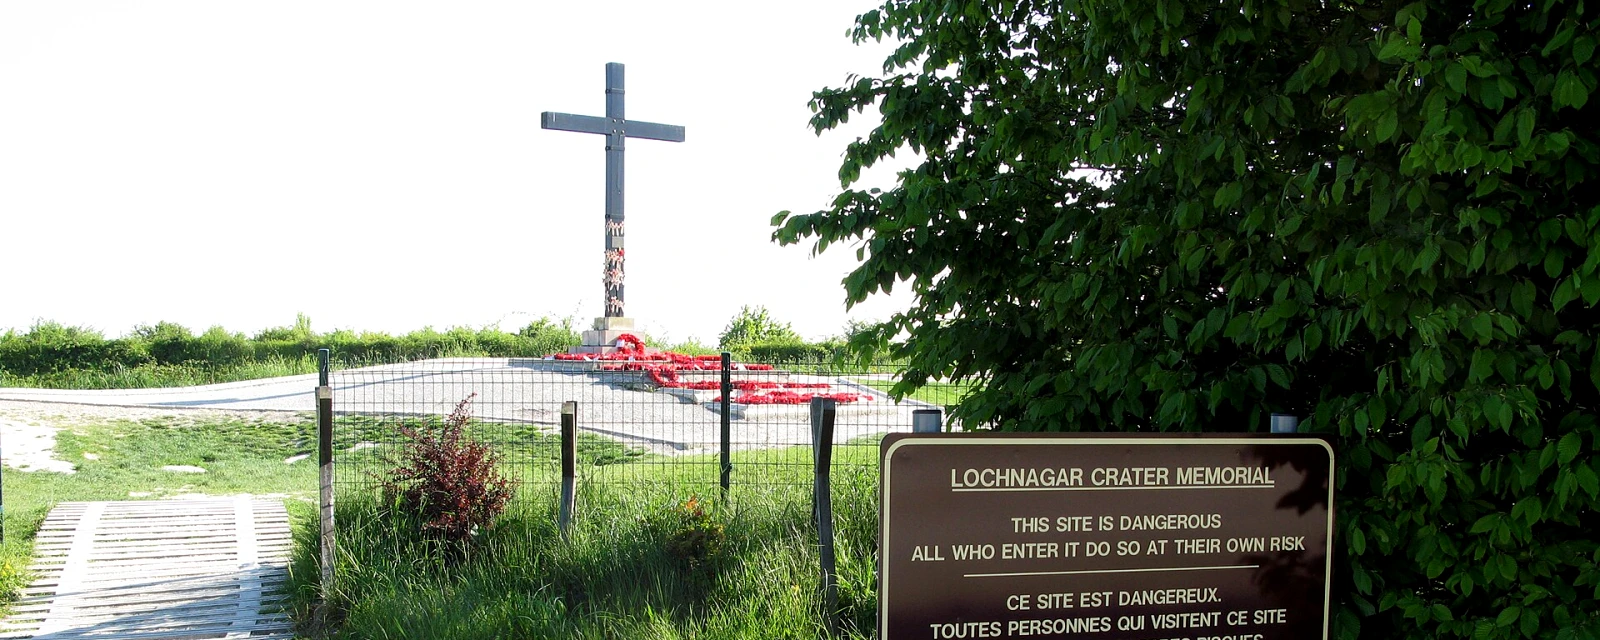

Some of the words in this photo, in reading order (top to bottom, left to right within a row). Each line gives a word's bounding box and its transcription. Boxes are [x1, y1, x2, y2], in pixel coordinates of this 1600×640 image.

[951, 468, 1084, 488] LOCHNAGAR
[1090, 467, 1169, 486] CRATER
[1176, 466, 1275, 485] MEMORIAL
[1011, 517, 1049, 533] THIS
[1056, 516, 1092, 532] SITE
[1098, 515, 1114, 531] IS
[1119, 513, 1221, 531] DANGEROUS
[911, 545, 944, 561] ALL
[952, 544, 996, 560] WHO
[1001, 543, 1058, 560] ENTER
[1064, 541, 1080, 558] IT
[1085, 541, 1111, 557] DO
[1116, 540, 1141, 556] SO
[1146, 539, 1169, 555] AT
[1174, 538, 1221, 555] THEIR
[1226, 537, 1265, 553] OWN
[1270, 535, 1306, 552] RISK
[1006, 594, 1031, 611] CE
[1036, 592, 1074, 610] SITE
[1080, 591, 1114, 608] EST
[1118, 587, 1222, 607] DANGEREUX.
[930, 620, 1001, 640] TOUTES
[1007, 616, 1112, 637] PERSONNES
[1117, 613, 1145, 632] QUI
[1150, 611, 1222, 630] VISITENT
[1226, 610, 1249, 627] CE
[1253, 608, 1287, 625] SITE
